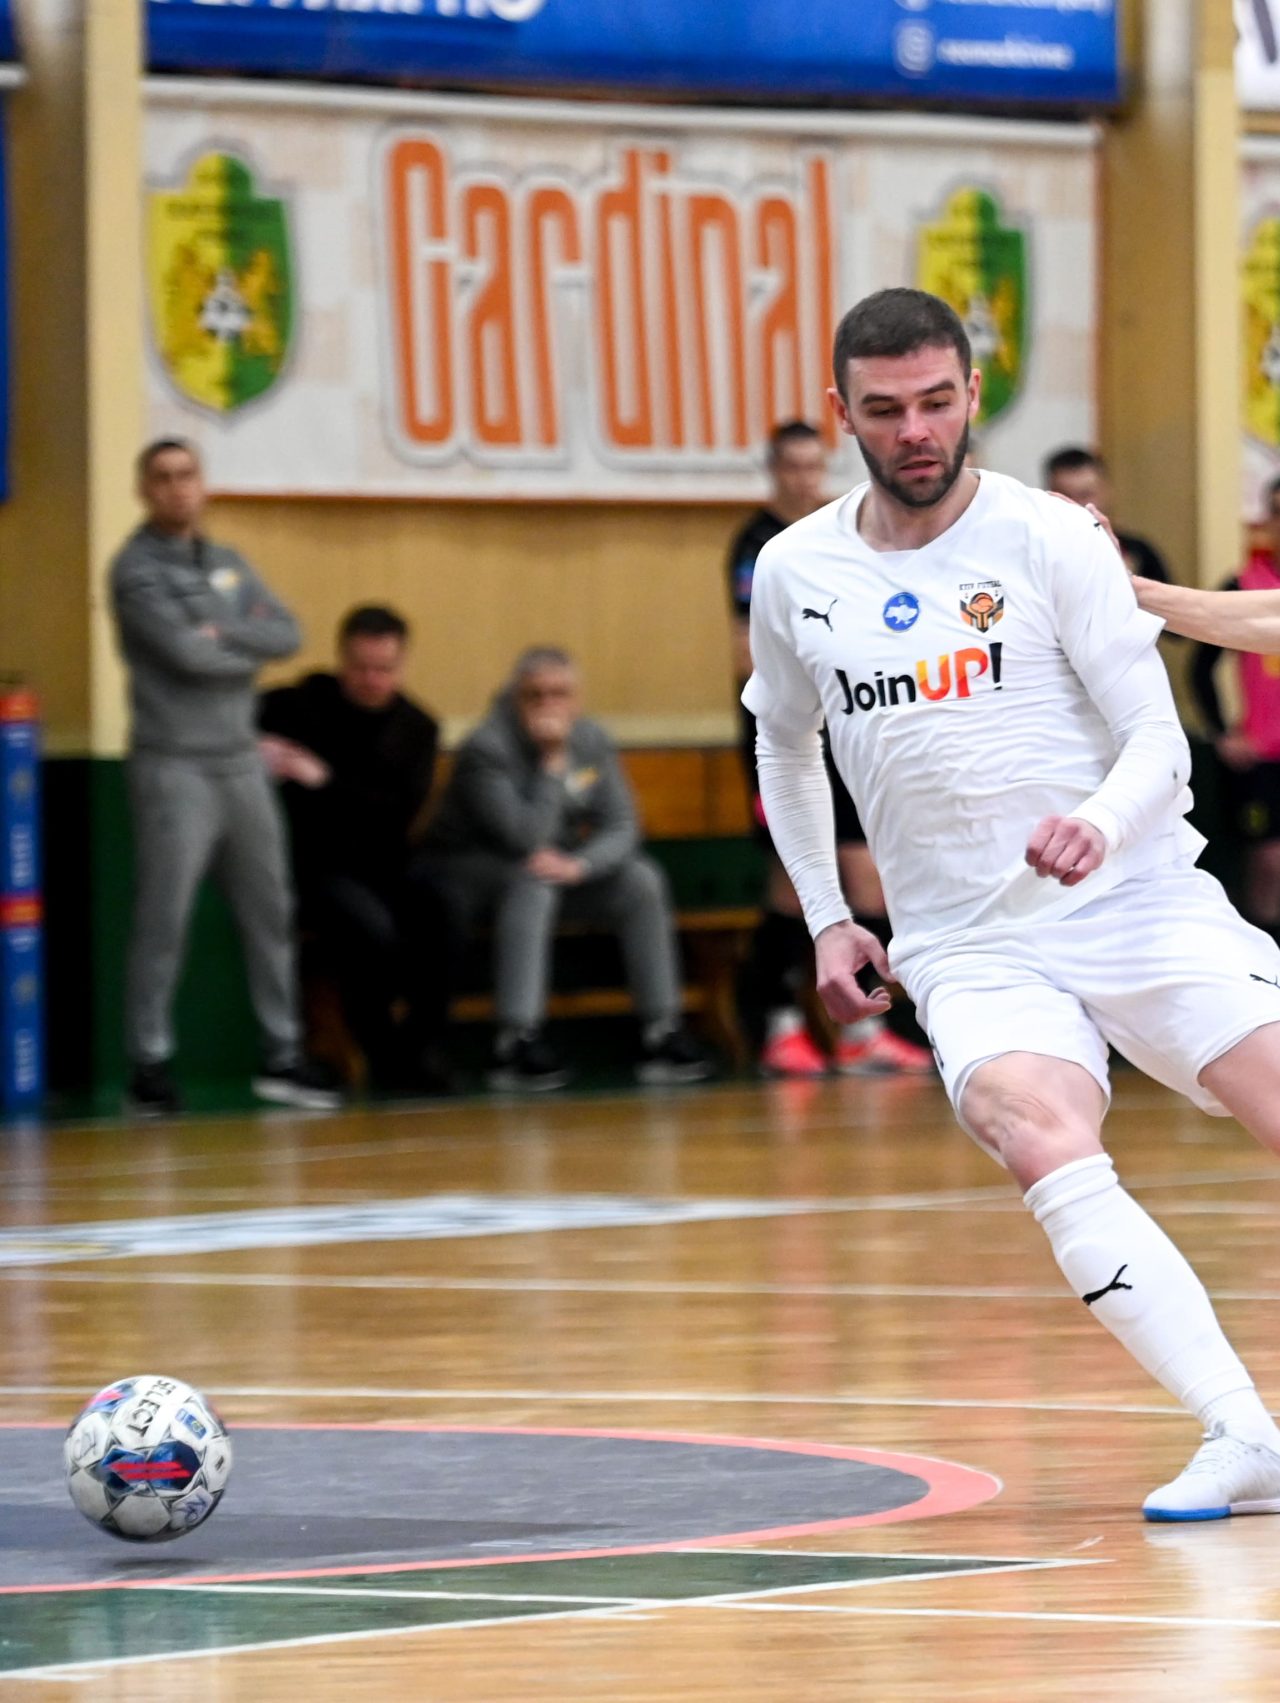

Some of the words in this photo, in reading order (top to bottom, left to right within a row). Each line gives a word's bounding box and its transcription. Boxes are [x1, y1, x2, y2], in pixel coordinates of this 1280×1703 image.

[388, 137, 838, 451] Cardinal
[834, 642, 1003, 716] JoinUP!
[127, 1379, 177, 1438] SELECT
